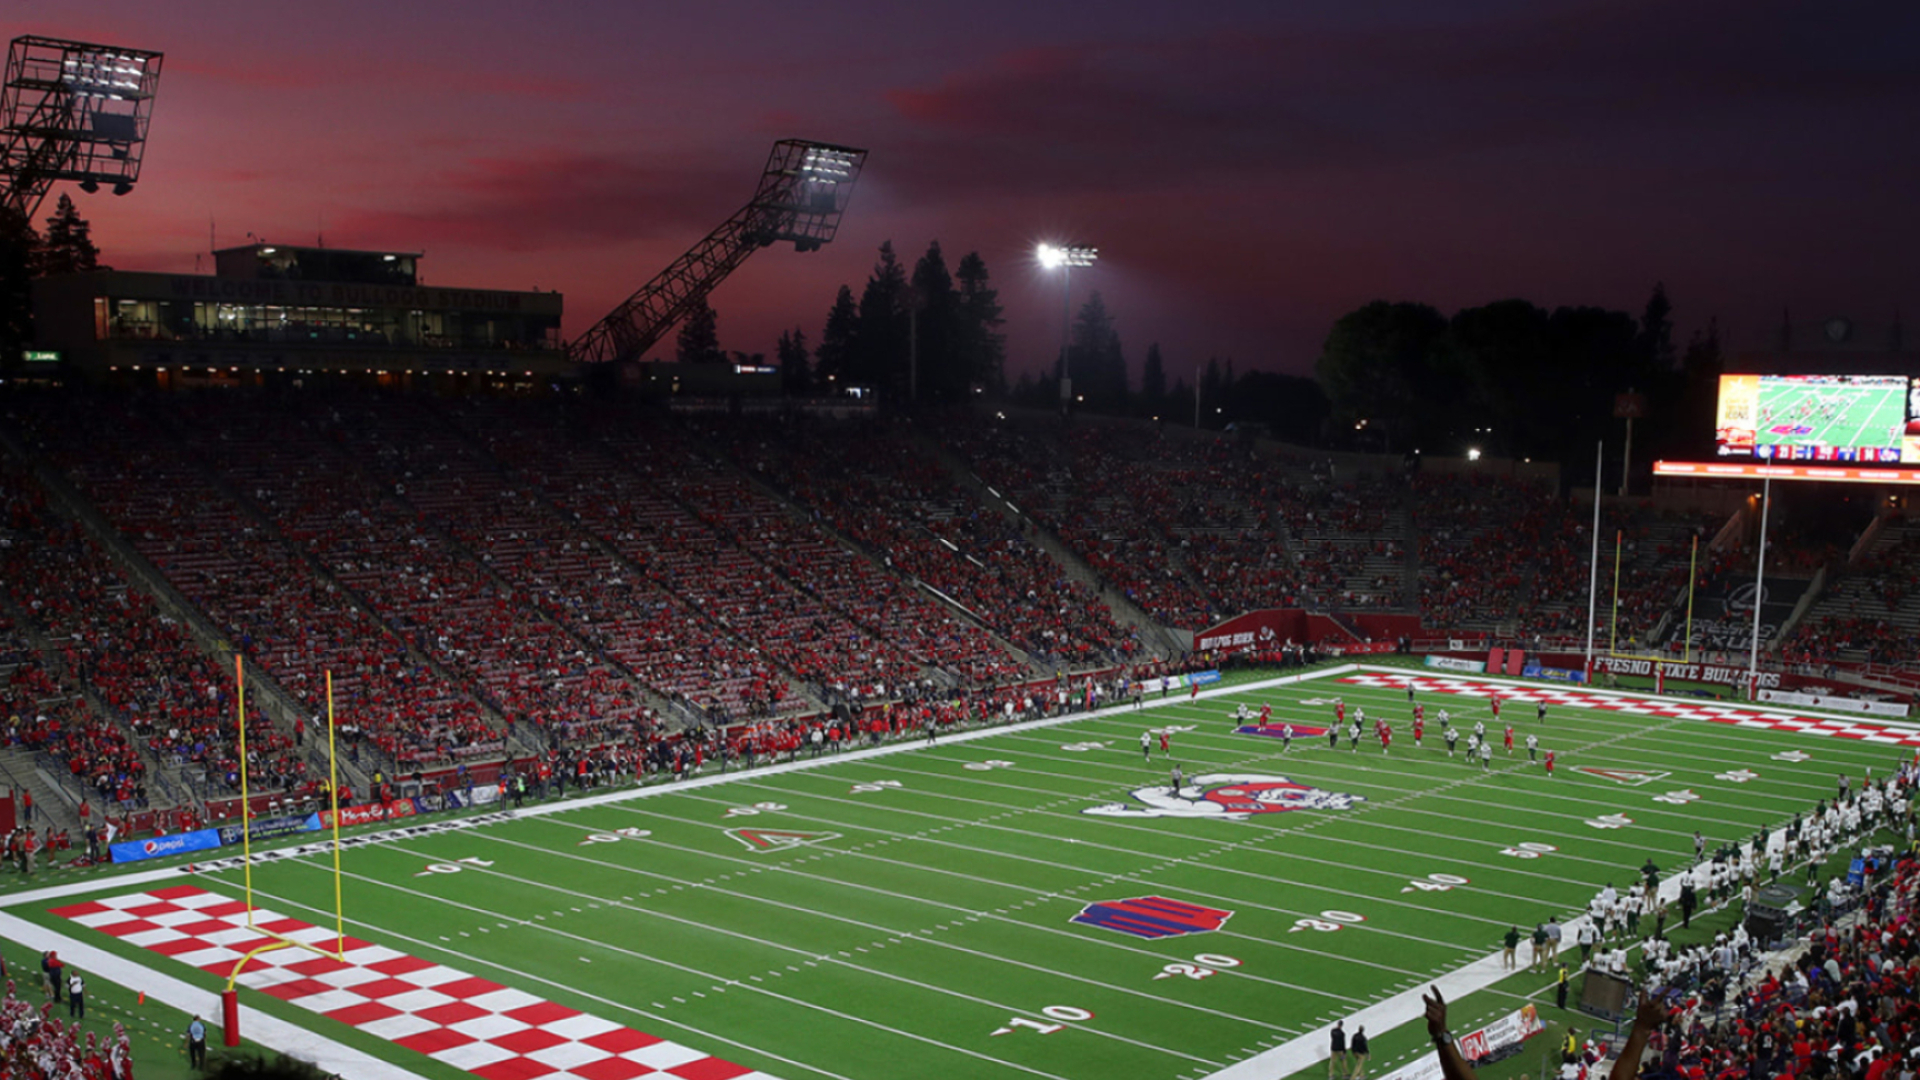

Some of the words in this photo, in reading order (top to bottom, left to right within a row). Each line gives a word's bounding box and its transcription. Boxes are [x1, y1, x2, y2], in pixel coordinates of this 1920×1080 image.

[171, 278, 286, 300] WELCOME
[297, 284, 321, 300] TO
[331, 286, 429, 306] BULLDOG
[438, 290, 521, 309] STADIUM
[1669, 631, 1768, 650] LEXUS
[1593, 656, 1651, 676] FRESNO
[1654, 662, 1700, 680] STATE
[1701, 669, 1781, 688] BULLDOGS
[157, 838, 185, 853] pepsi
[1499, 841, 1559, 859] 50
[1409, 872, 1471, 892] 40
[1294, 910, 1368, 932] 30
[1162, 953, 1244, 980] 20
[1008, 1004, 1096, 1035] 10
